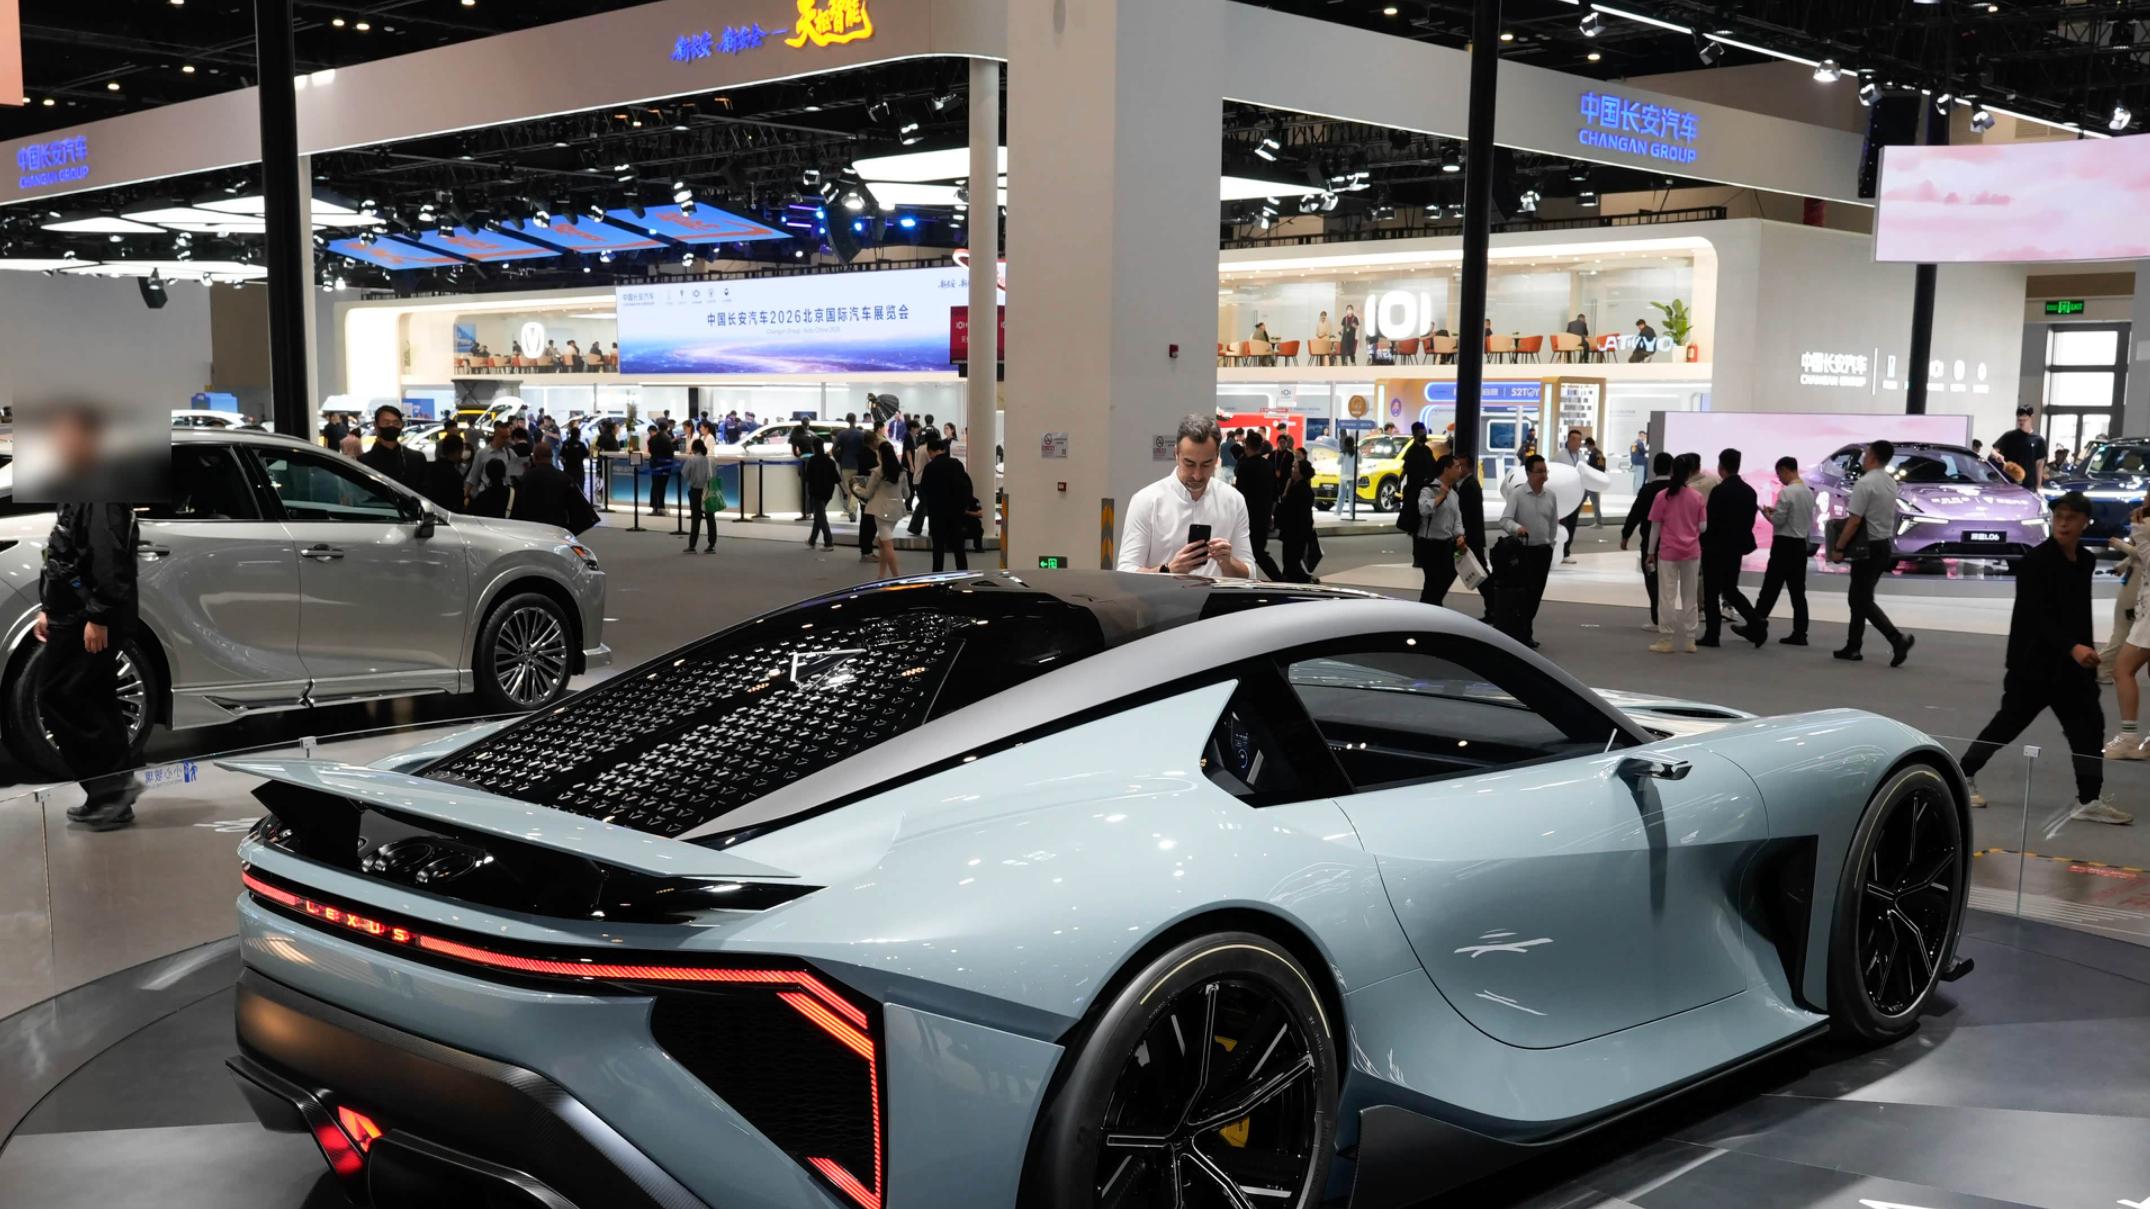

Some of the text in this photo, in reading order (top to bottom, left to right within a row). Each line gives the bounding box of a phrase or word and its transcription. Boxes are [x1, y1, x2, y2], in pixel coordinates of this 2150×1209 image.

[1581, 92, 1698, 143] 中国长安汽车
[1579, 129, 1697, 164] CHANGAN GROUP
[707, 304, 909, 327] 中国长安汽车2026北京国际汽车展览会
[306, 900, 410, 942] LEXUS
